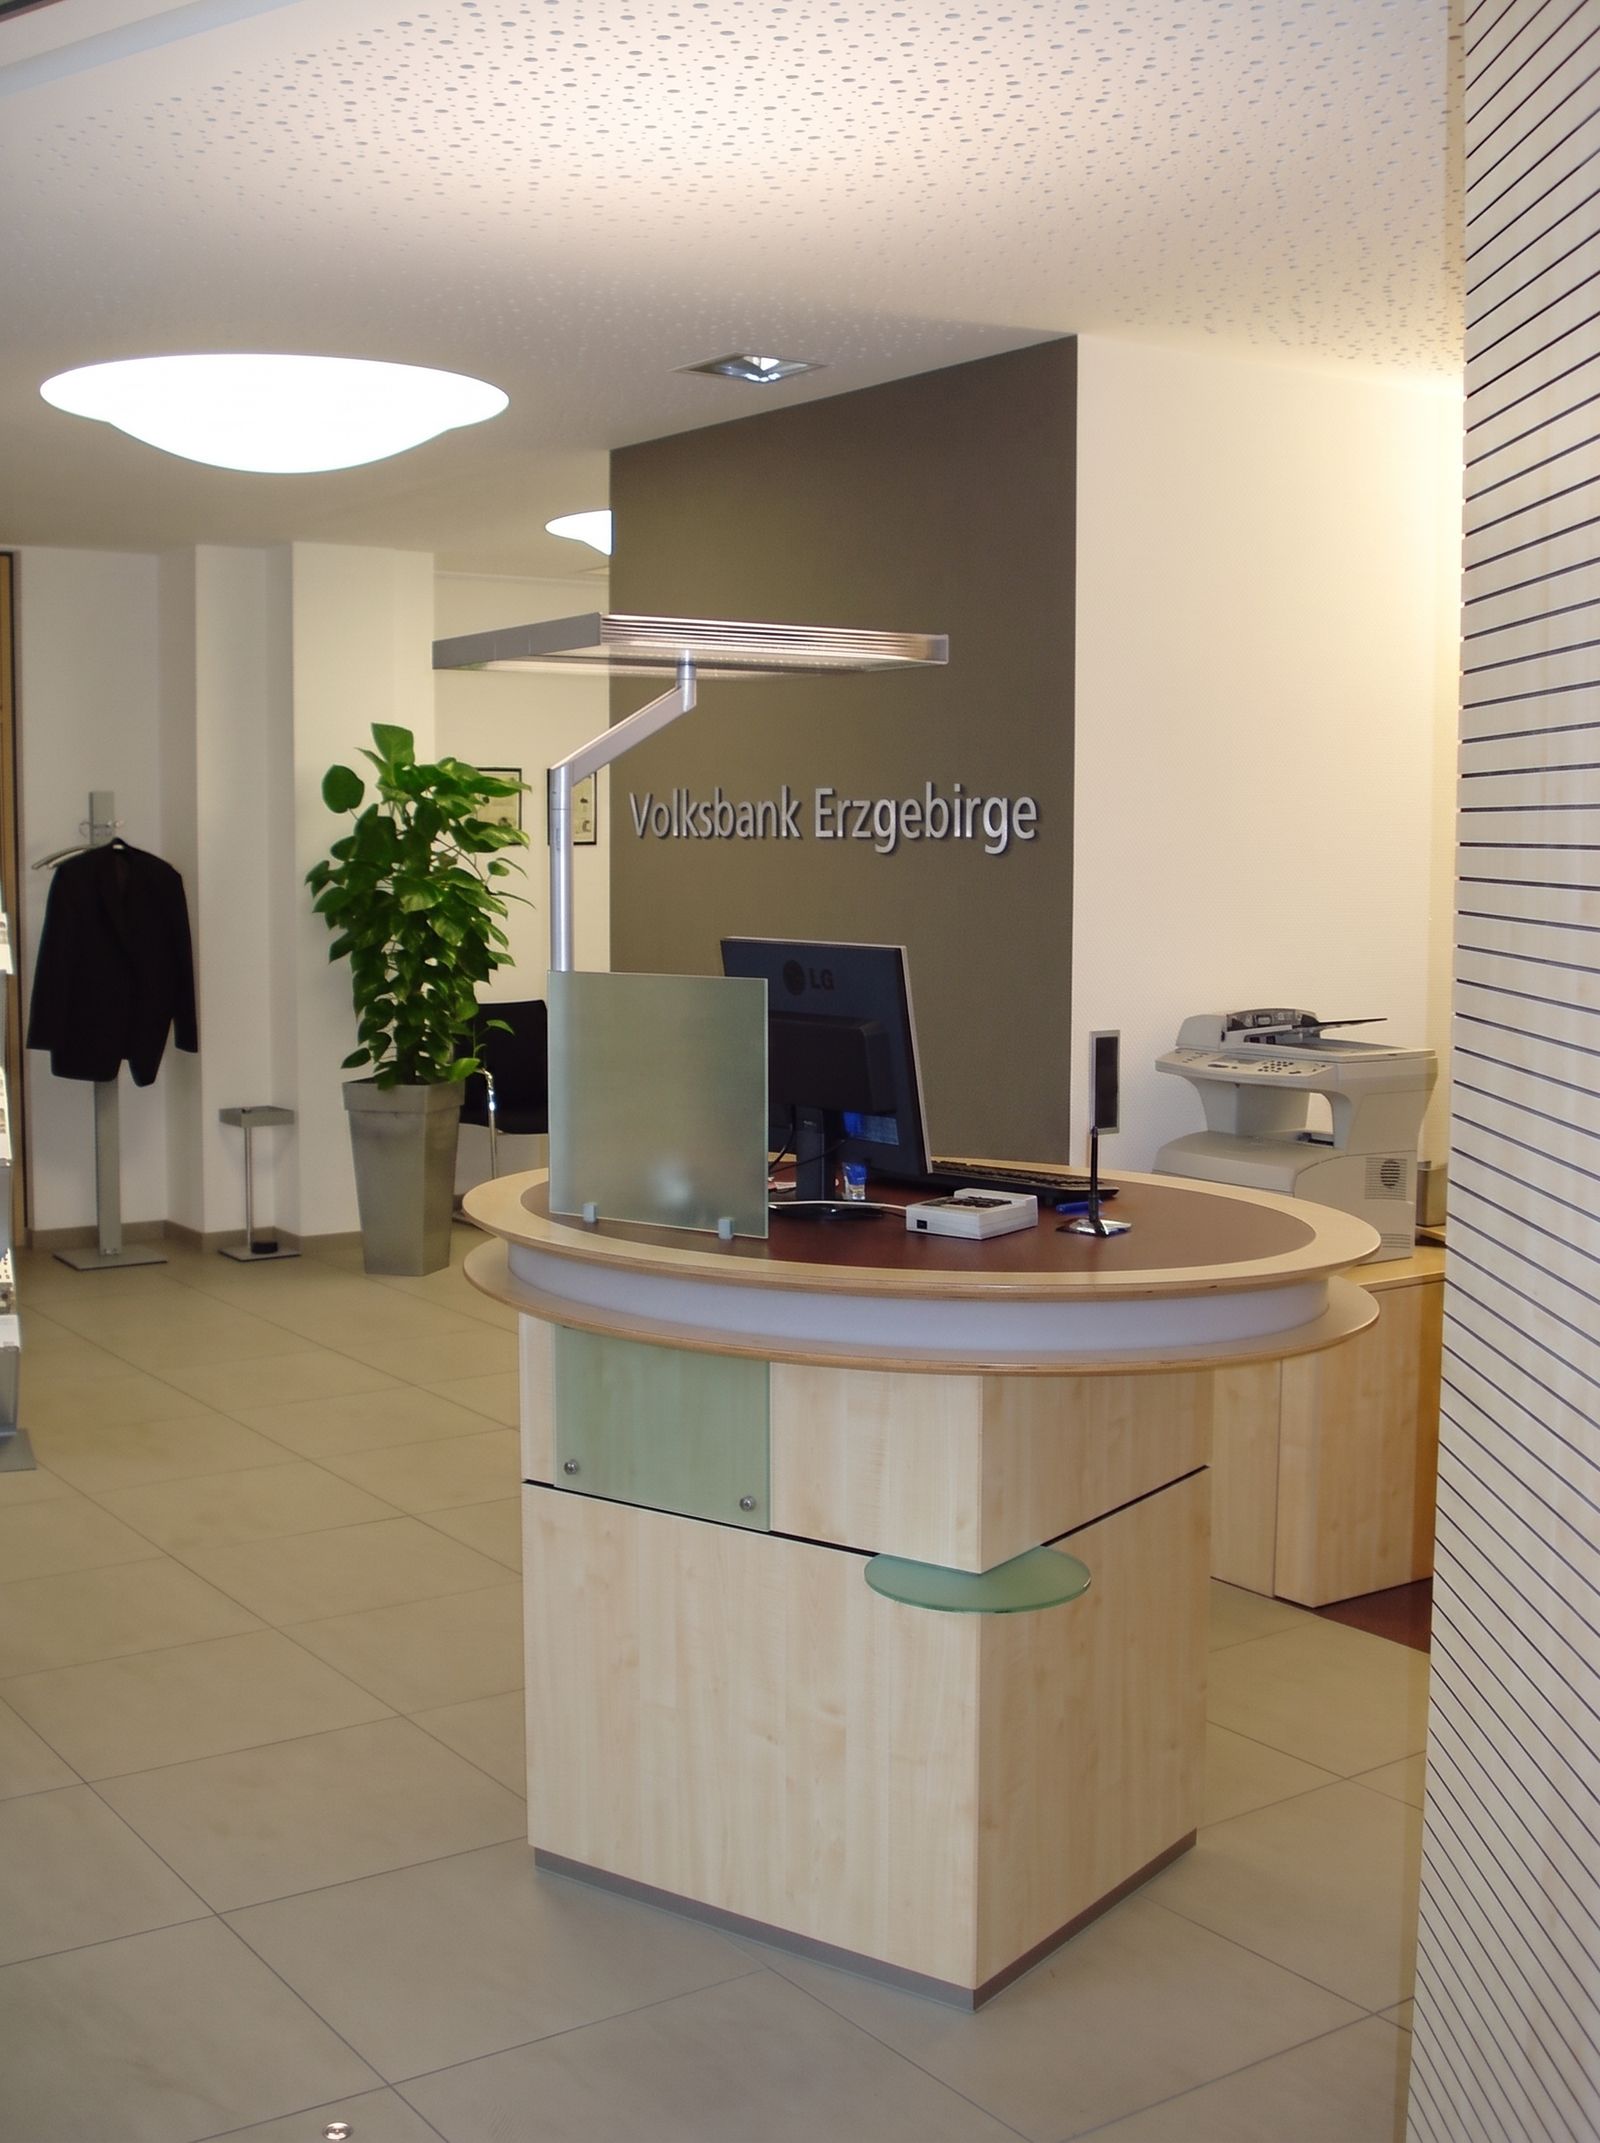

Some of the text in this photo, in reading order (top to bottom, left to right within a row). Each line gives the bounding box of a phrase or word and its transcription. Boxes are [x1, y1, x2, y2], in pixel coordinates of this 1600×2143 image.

[629, 781, 1038, 854] Volksbank Erzgebirge
[809, 968, 835, 990] LG
